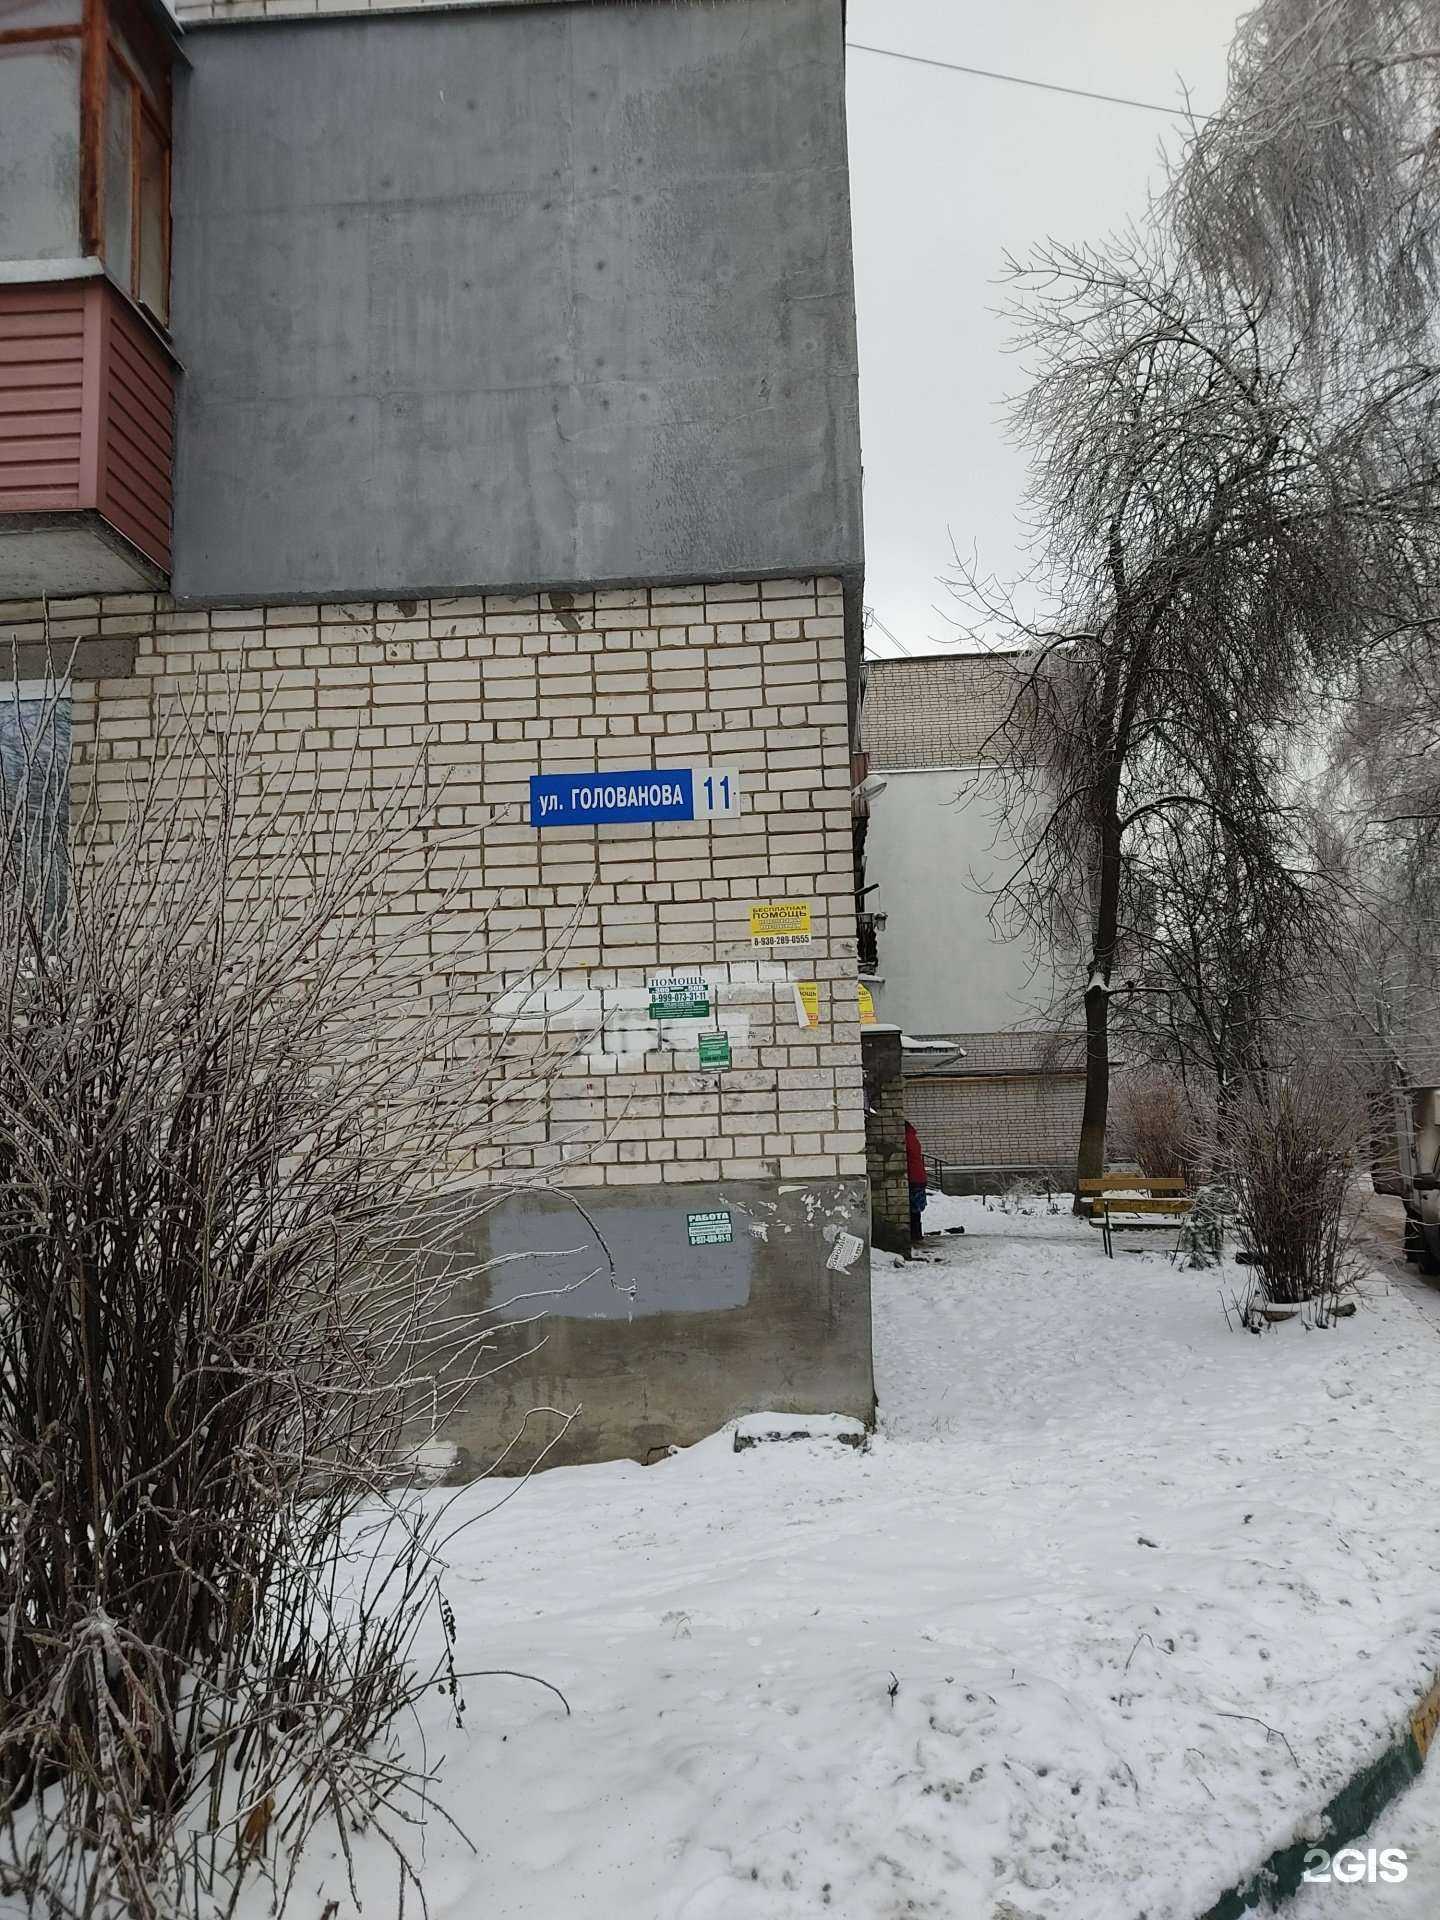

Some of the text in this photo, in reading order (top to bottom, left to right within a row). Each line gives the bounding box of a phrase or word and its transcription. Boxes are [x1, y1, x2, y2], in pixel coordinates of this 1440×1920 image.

[703, 775, 730, 810] 11
[539, 784, 684, 816] ул. ГОЛОВАНОВА
[752, 905, 807, 913] БЕСПЛАТНАЯ
[752, 910, 807, 919] ПОМОЩЬ
[651, 976, 706, 987] ПОМОЩЬ
[688, 1212, 729, 1222] РАБОТА
